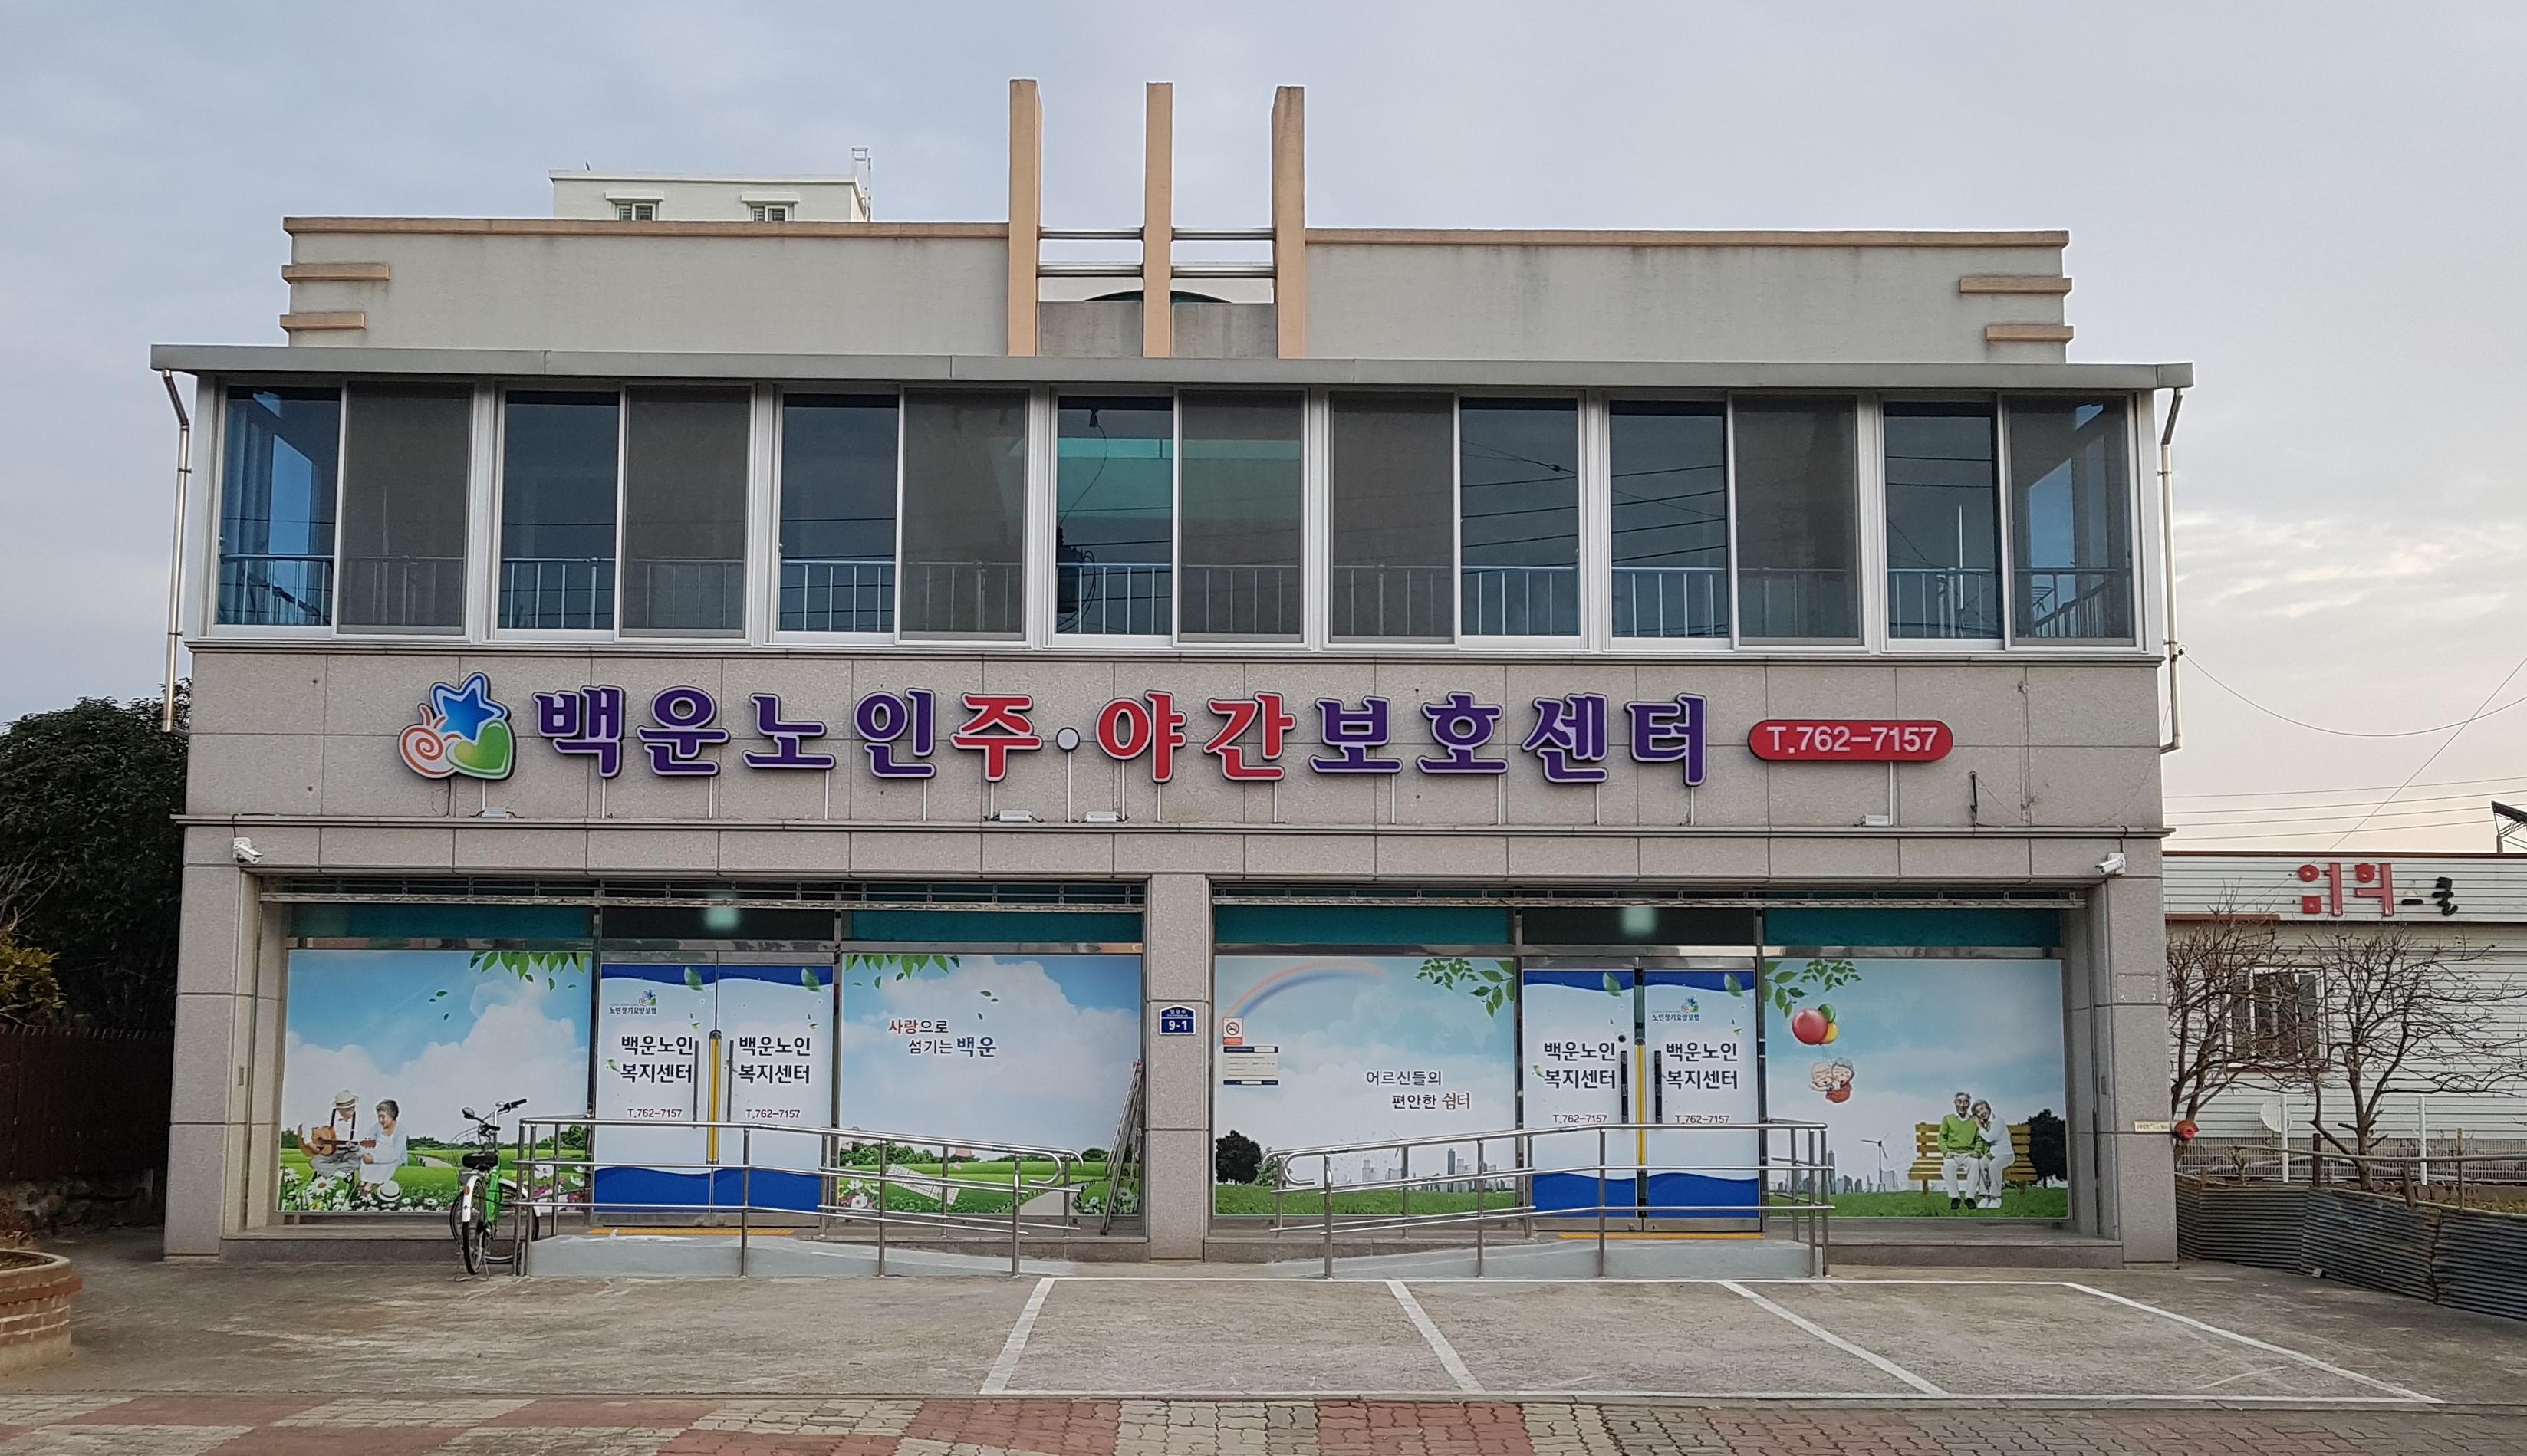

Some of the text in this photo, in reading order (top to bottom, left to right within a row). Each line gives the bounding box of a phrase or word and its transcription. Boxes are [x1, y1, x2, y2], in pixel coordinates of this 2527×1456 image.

[1766, 726, 1938, 754] T.762-7157
[888, 1019, 949, 1034] 사랑으로
[1168, 1020, 1187, 1030] 9-1
[621, 1037, 693, 1055] 백운노인
[739, 1037, 811, 1057] 백운노인
[908, 1037, 997, 1057] 섬기는 백운
[1544, 1042, 1616, 1061] 백운노인
[1666, 1043, 1738, 1062] 백운노인
[620, 1063, 692, 1083] 복지센터
[738, 1064, 810, 1084] 복지센터
[1366, 1070, 1442, 1086] 어르신들의
[1544, 1070, 1616, 1089] 복지센터
[1666, 1070, 1739, 1090] 복지센터
[1391, 1092, 1471, 1110] 편안한 쉼터
[627, 1109, 683, 1119] T.762-7157
[746, 1109, 801, 1119] T.762-7157
[1553, 1114, 1607, 1124] T.762-7157
[1675, 1115, 1730, 1125] T.762-7157
